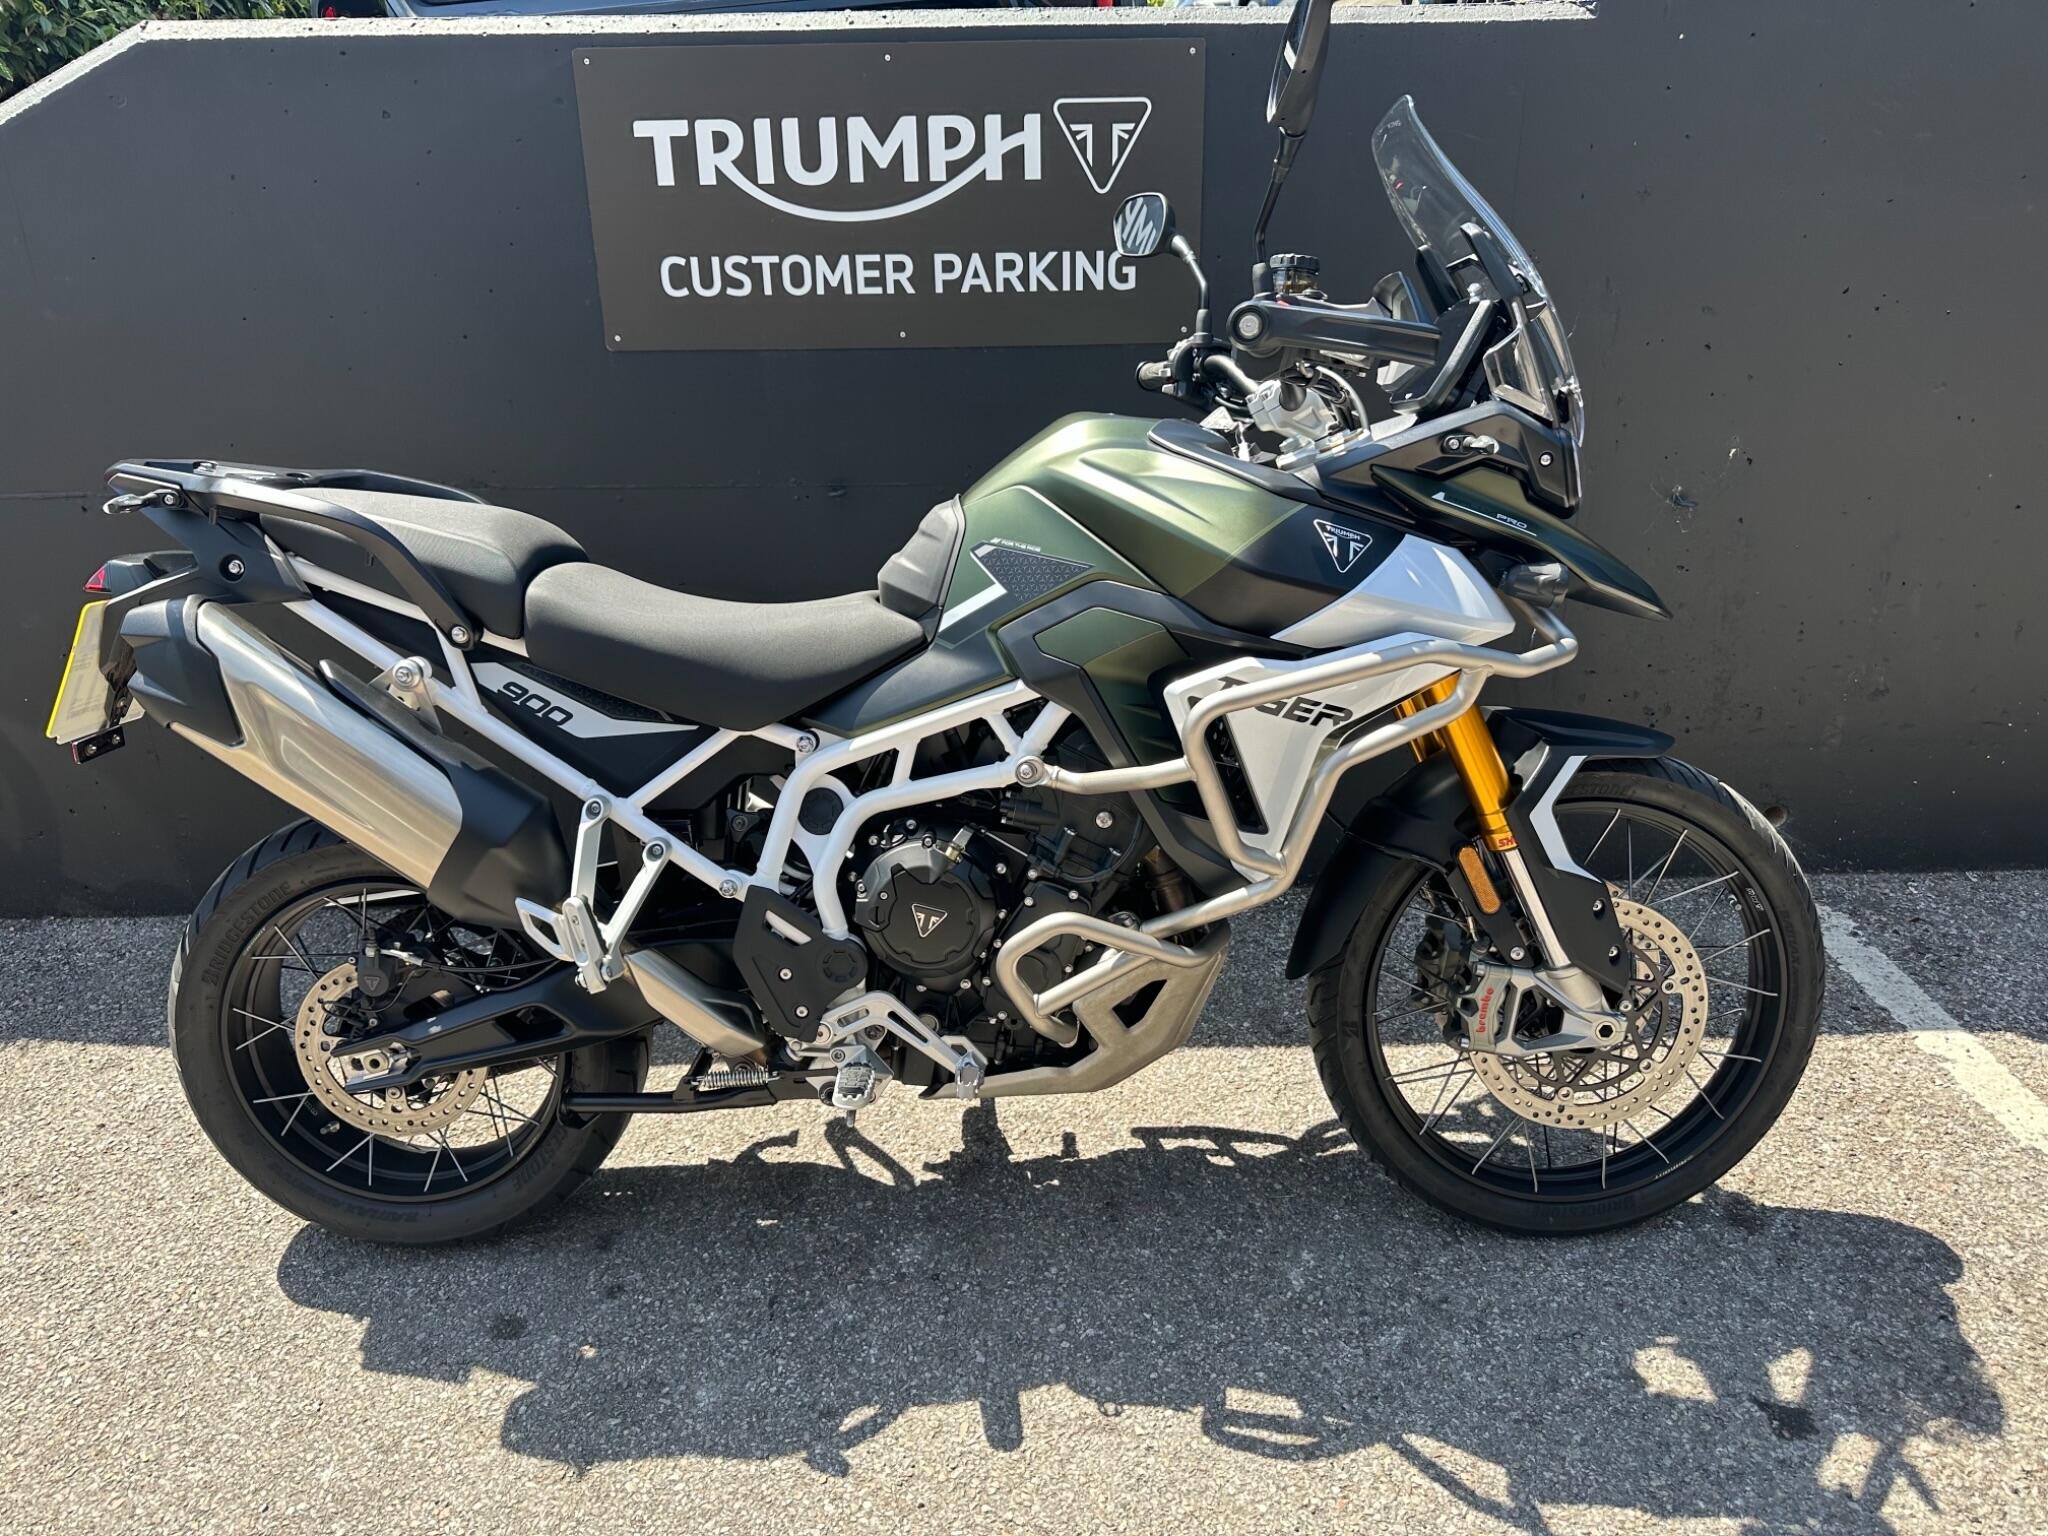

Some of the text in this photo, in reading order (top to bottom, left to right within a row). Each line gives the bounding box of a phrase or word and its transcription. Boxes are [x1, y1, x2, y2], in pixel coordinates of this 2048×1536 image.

[633, 113, 1042, 222] TRIUMPH
[660, 250, 1137, 298] CUSTOMER PARKING
[1325, 524, 1361, 541] TRIUMPH
[1496, 513, 1528, 529] PRO
[498, 681, 574, 736] 900
[1217, 676, 1354, 727] TGER
[201, 881, 293, 986] BRIDGESTONE
[1476, 988, 1494, 1032] brembo
